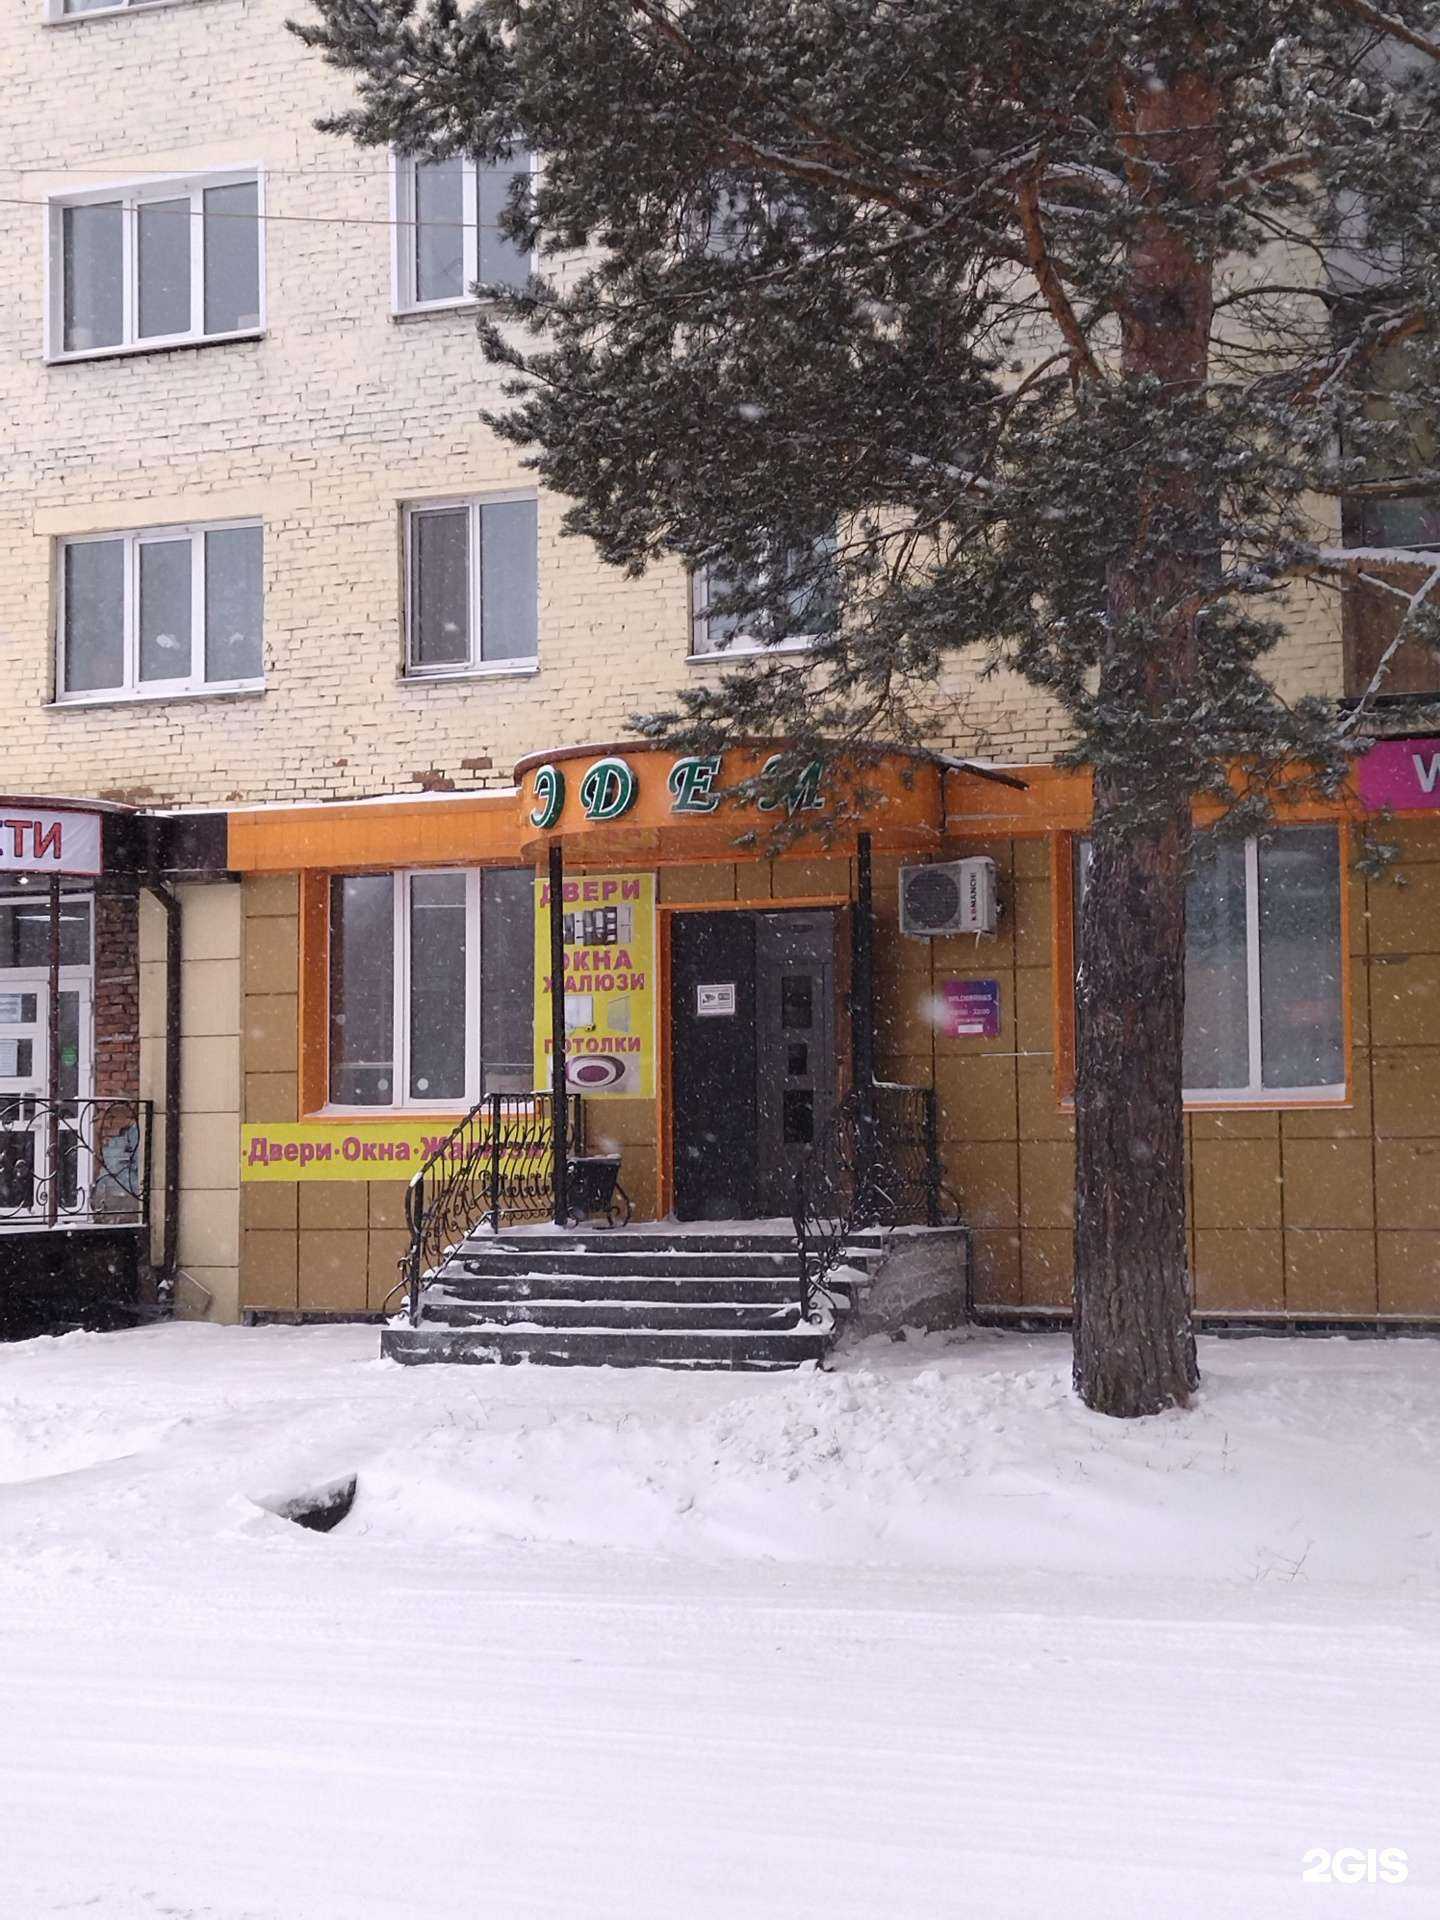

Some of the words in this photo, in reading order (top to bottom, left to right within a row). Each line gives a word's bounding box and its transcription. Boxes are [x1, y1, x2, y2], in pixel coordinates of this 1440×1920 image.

[0, 819, 62, 859] ТИ
[248, 1136, 333, 1167] Двери
[342, 1136, 412, 1161] Окна
